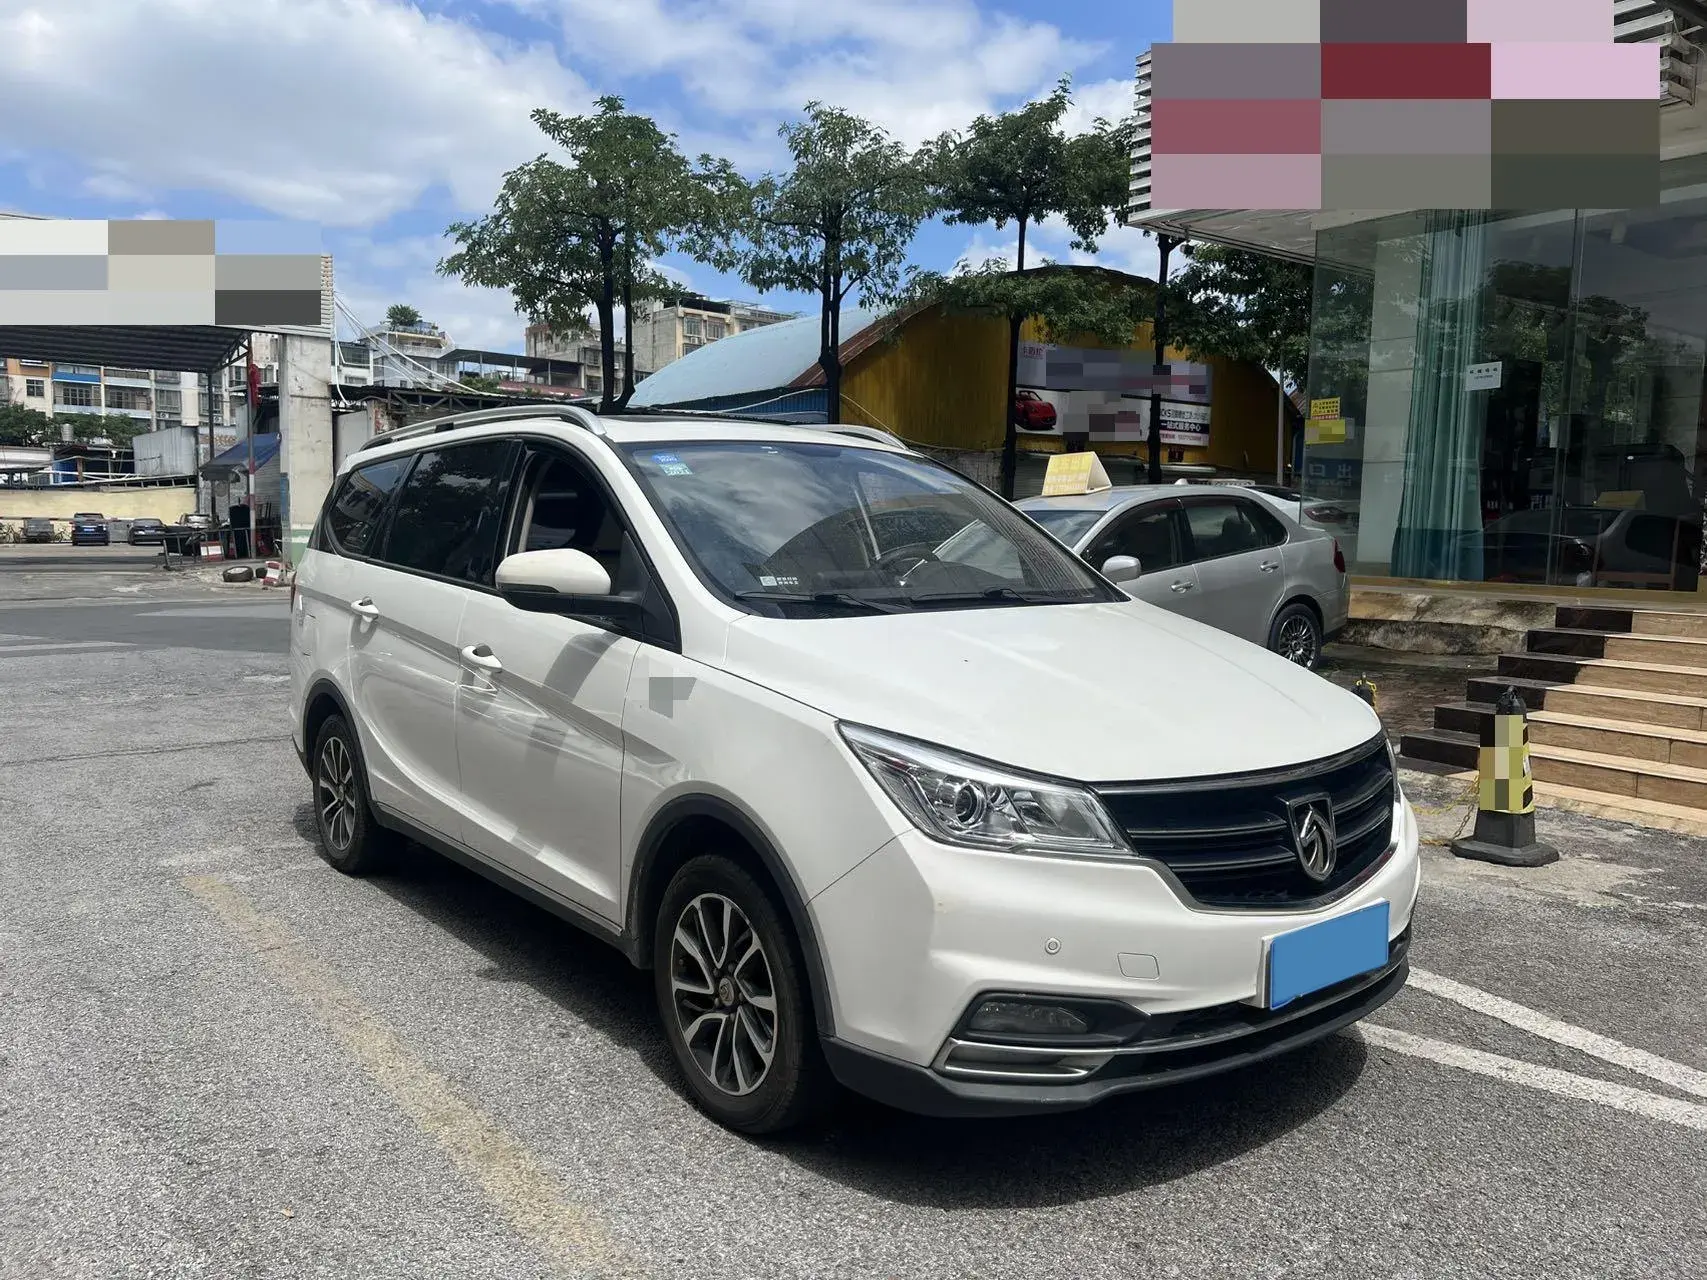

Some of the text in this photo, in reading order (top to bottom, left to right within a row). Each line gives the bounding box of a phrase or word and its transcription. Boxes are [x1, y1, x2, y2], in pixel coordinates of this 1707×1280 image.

[1161, 421, 1201, 431] 一站式服务中心
